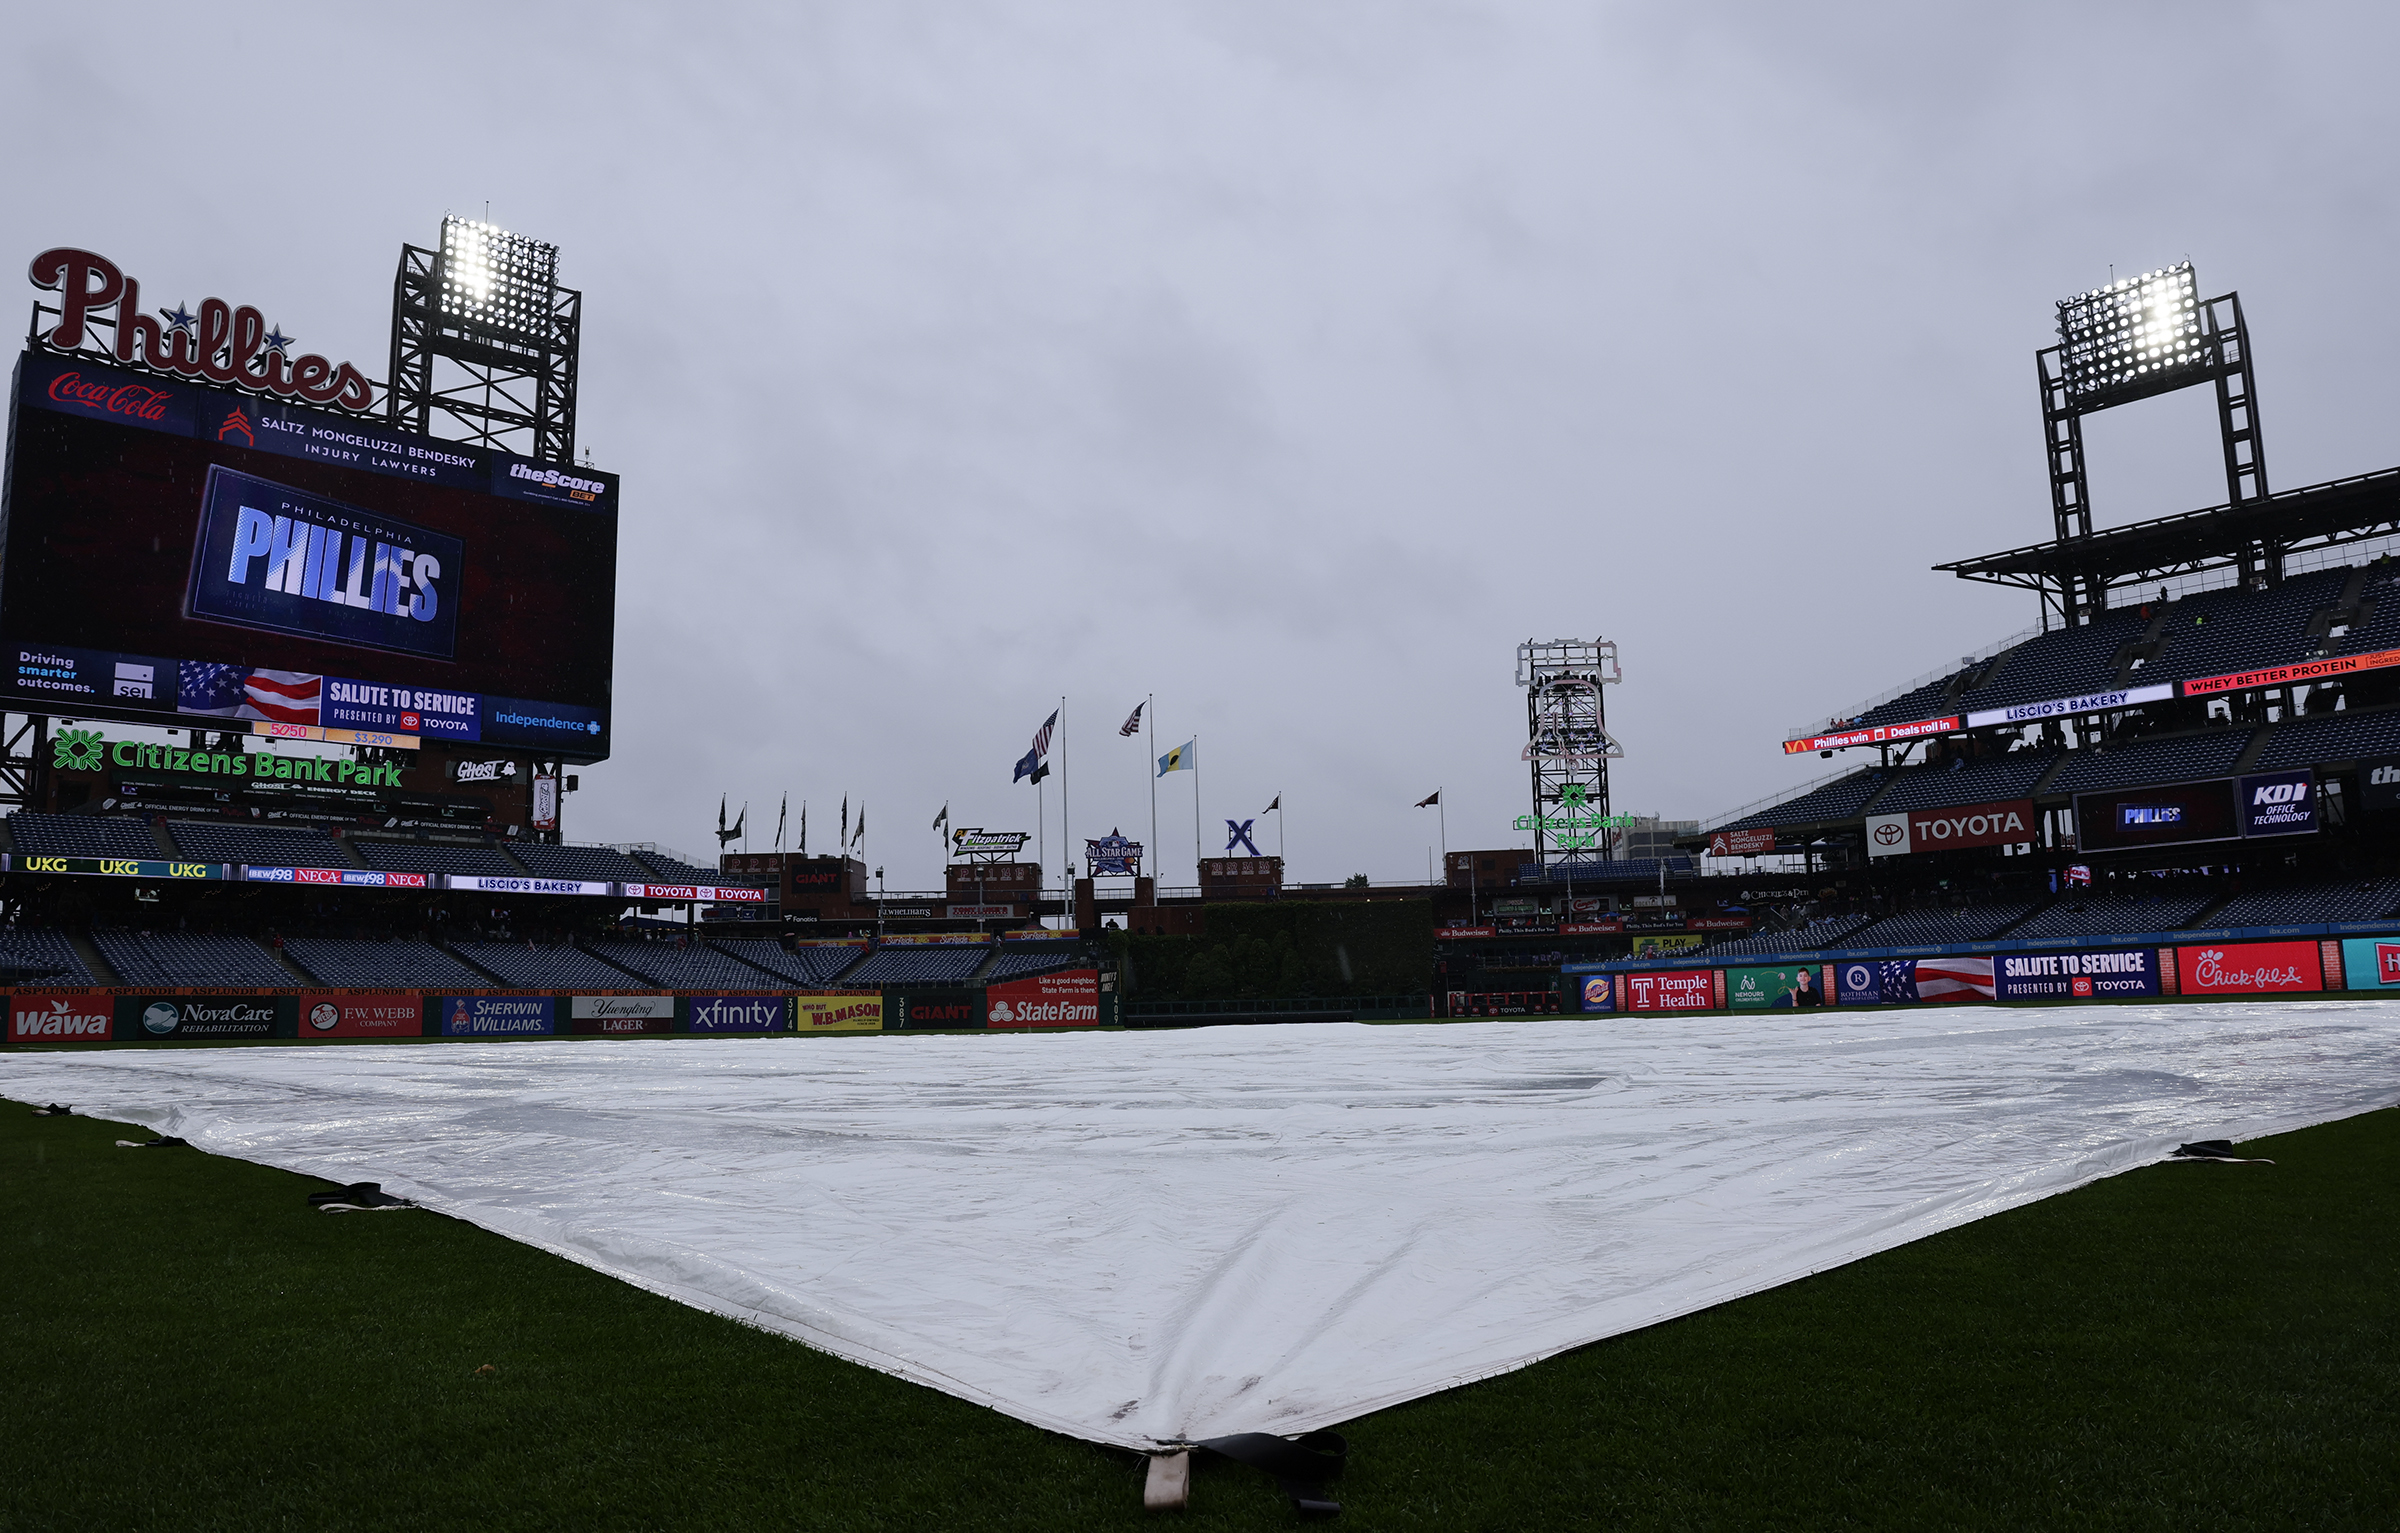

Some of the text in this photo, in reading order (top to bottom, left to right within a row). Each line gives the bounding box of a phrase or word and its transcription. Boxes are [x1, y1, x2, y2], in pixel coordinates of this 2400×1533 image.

[28, 246, 374, 411] Phillies
[48, 371, 175, 421] Coca-Cola
[261, 416, 476, 469] SALTZ MONGELUZZI BENDESKY
[305, 443, 437, 477] INJURY LAWYERS
[509, 463, 606, 495] theScore
[572, 491, 594, 501] BET
[281, 502, 412, 544] PHILADELPHIA
[227, 505, 442, 623] PHILLIES
[19, 651, 75, 669] Driving
[18, 665, 77, 680] smarter
[2190, 659, 2357, 693] WHEY BETTER PROTEIN
[17, 677, 96, 694] outcomes.
[330, 681, 475, 716] SALUTE TO SERVICE
[2006, 692, 2128, 721] LISCIO'S BAKERY
[333, 708, 397, 725] PRESENTED BY
[423, 718, 469, 732] TOYOTA
[495, 711, 585, 732] Independence
[354, 732, 393, 746] $3,290
[1813, 720, 1950, 750] Phillies win Deals roll in
[112, 740, 403, 788] Citizens Bank Park
[456, 760, 506, 783] GHOST
[250, 781, 291, 791] GHOST
[306, 785, 348, 796] ENERGY
[350, 788, 377, 797] DECK
[2253, 783, 2308, 806] KDI
[144, 803, 206, 814] OFFICIAL ENERGY DRINK
[2124, 807, 2181, 825] PHILLIES
[2266, 803, 2296, 815] OFFICE
[289, 812, 345, 824] OFFICIAL ENERGY DRINK
[420, 821, 471, 831] OFFICIAL ENERGY DRINK
[1516, 811, 1635, 830] Citizens Bank
[1915, 811, 2025, 841] TOYOTA
[2253, 810, 2311, 826] TECHNOLOGY
[960, 830, 1022, 846] Fitzpatrick
[1557, 831, 1596, 849] Park
[1729, 830, 1773, 851] SALTZ MONGELUZZI BENDESKY
[1086, 846, 1143, 857] ALL STAR GAME
[25, 856, 207, 878] UKG UKG UKG
[298, 870, 427, 887] NECA NECA
[478, 879, 582, 893] LISCIO'S BAKERY
[795, 873, 837, 884] GIANT
[648, 886, 762, 900] TOYOTA TOYOTA
[792, 915, 818, 923] Fanatics
[1706, 919, 1745, 928] Budweiser
[1451, 929, 1490, 937] Budweiser
[1578, 924, 1617, 933] Budweiser
[1632, 961, 1651, 969] ibx.com
[1672, 958, 1706, 966] Independence
[1779, 952, 1815, 961] Independence
[1896, 945, 1936, 954] Independence
[1971, 943, 1996, 951] ibx.com
[2026, 938, 2070, 948] Independence
[2111, 935, 2139, 943] ibx.com
[2173, 929, 2222, 940] Independence
[2268, 926, 2300, 935] ibx.com
[2339, 921, 2396, 931] Independence
[1662, 938, 1687, 949] PLAY
[2005, 952, 2146, 978] SALUTE TO SERVICE
[2196, 954, 2303, 987] Chick-fil-A
[1038, 976, 1097, 987] Like good neighbor,
[1041, 986, 1080, 994] State Farm is
[1657, 975, 1708, 992] Temple
[2007, 979, 2146, 995] PRESENTED BY TOYOTA
[13, 987, 90, 995] ASPLUNDH
[105, 987, 177, 995] ASPLUNDH
[190, 988, 258, 996] ASPLUNDH
[270, 988, 334, 996] ASPLUNDH
[347, 988, 407, 996] ASPLUNDH
[1658, 991, 1706, 1008] Health
[181, 1003, 273, 1022] NovaCare
[344, 1008, 416, 1019] F.W. WEBB
[474, 1000, 543, 1015] SHERWIN
[590, 998, 656, 1018] Yuengling
[695, 999, 778, 1028] xfinity
[802, 1003, 827, 1011] WHO BUT
[910, 1004, 972, 1021] GIANT
[1499, 1006, 1526, 1014] TOYOTA
[16, 1011, 106, 1036] Wawa
[181, 1023, 269, 1033] REHABILITATION
[359, 1020, 399, 1028] COMPANY
[472, 1016, 543, 1032] WILLIAMS
[602, 1019, 644, 1032] LAGER
